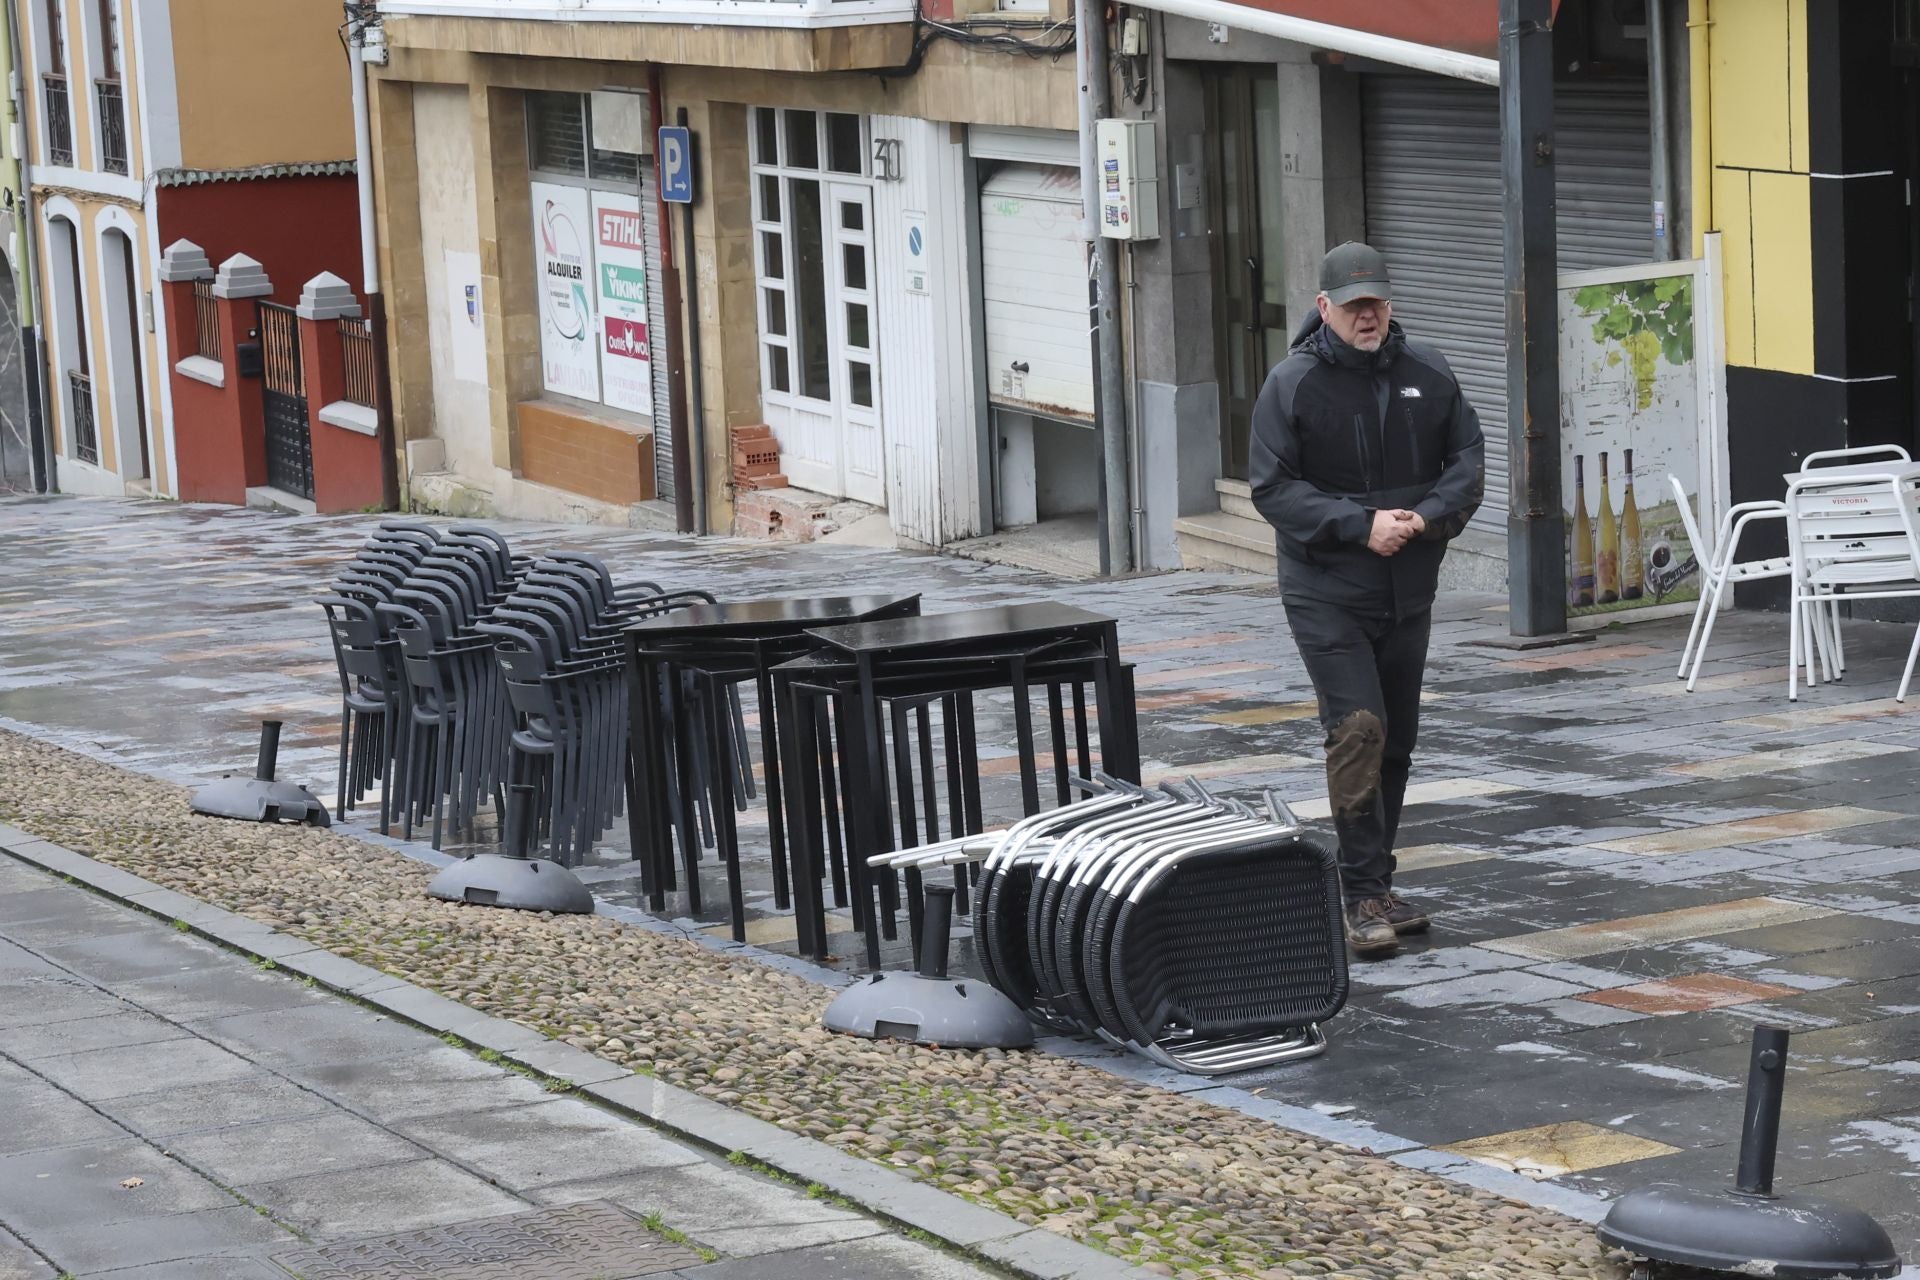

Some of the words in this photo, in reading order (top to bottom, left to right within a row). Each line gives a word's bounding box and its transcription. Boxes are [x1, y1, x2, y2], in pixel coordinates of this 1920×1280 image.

[664, 137, 682, 192] P
[874, 138, 902, 181] 30
[602, 214, 642, 246] STIHL
[548, 261, 582, 280] ALQUILER
[609, 278, 643, 302] VIKING
[1832, 497, 1868, 505] VICTORIA
